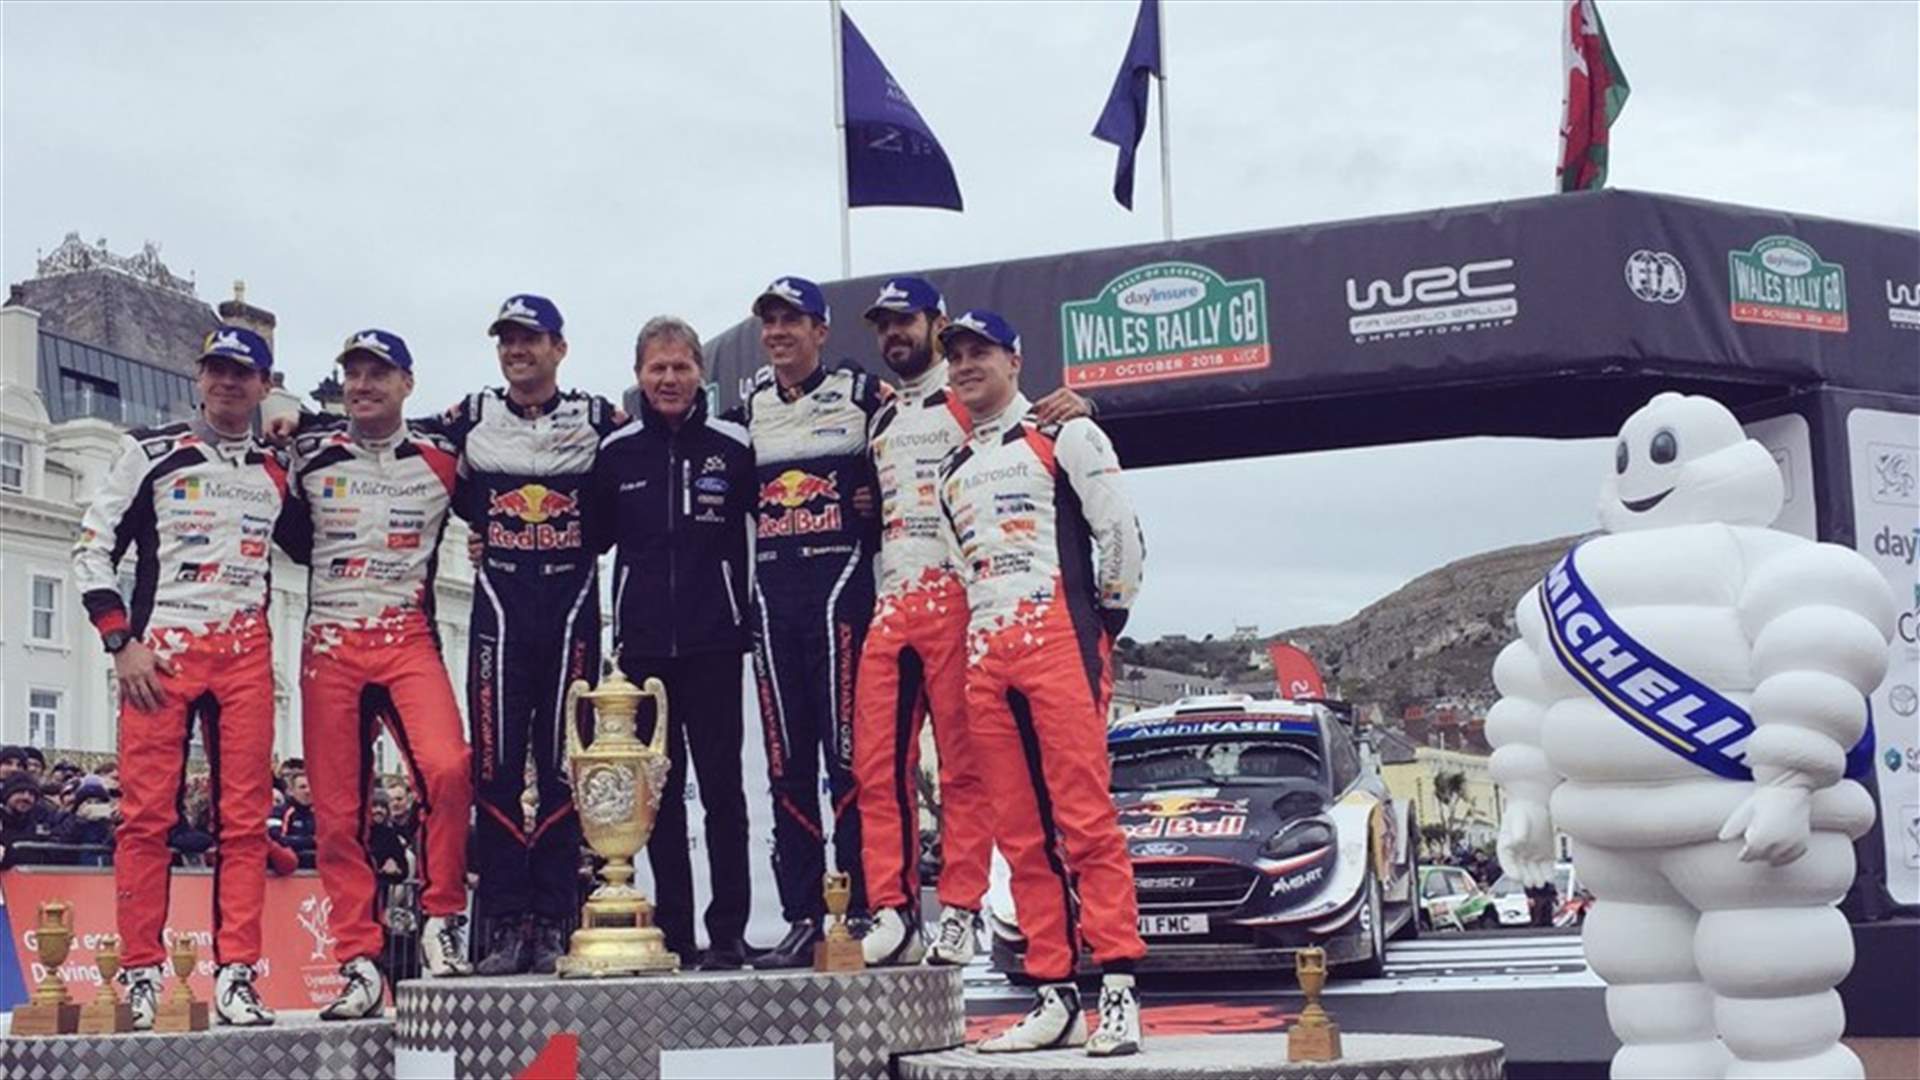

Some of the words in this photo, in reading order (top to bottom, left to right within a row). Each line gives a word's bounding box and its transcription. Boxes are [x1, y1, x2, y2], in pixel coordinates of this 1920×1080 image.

[1346, 258, 1516, 312] WRC
[1631, 259, 1681, 297] FIA
[1734, 258, 1783, 303] WALES
[1785, 276, 1822, 309] RALLY
[1124, 284, 1199, 307] dayinsure
[1071, 311, 1149, 361] WALES
[1155, 302, 1222, 352] RALLY
[1229, 290, 1259, 342] GB
[1355, 318, 1514, 345] CHAMPIONSHIP
[1115, 358, 1184, 377] OCTOBER
[1190, 353, 1224, 369] 2018
[889, 430, 950, 448] Microsoft
[964, 462, 1029, 489] Microsoft
[205, 481, 273, 504] Microsoft
[351, 481, 428, 498] Microsoft
[794, 503, 842, 535] Bull
[488, 521, 535, 550] Red
[537, 521, 582, 550] Bull
[1165, 815, 1247, 838] Bull
[1156, 916, 1191, 932] FMC
